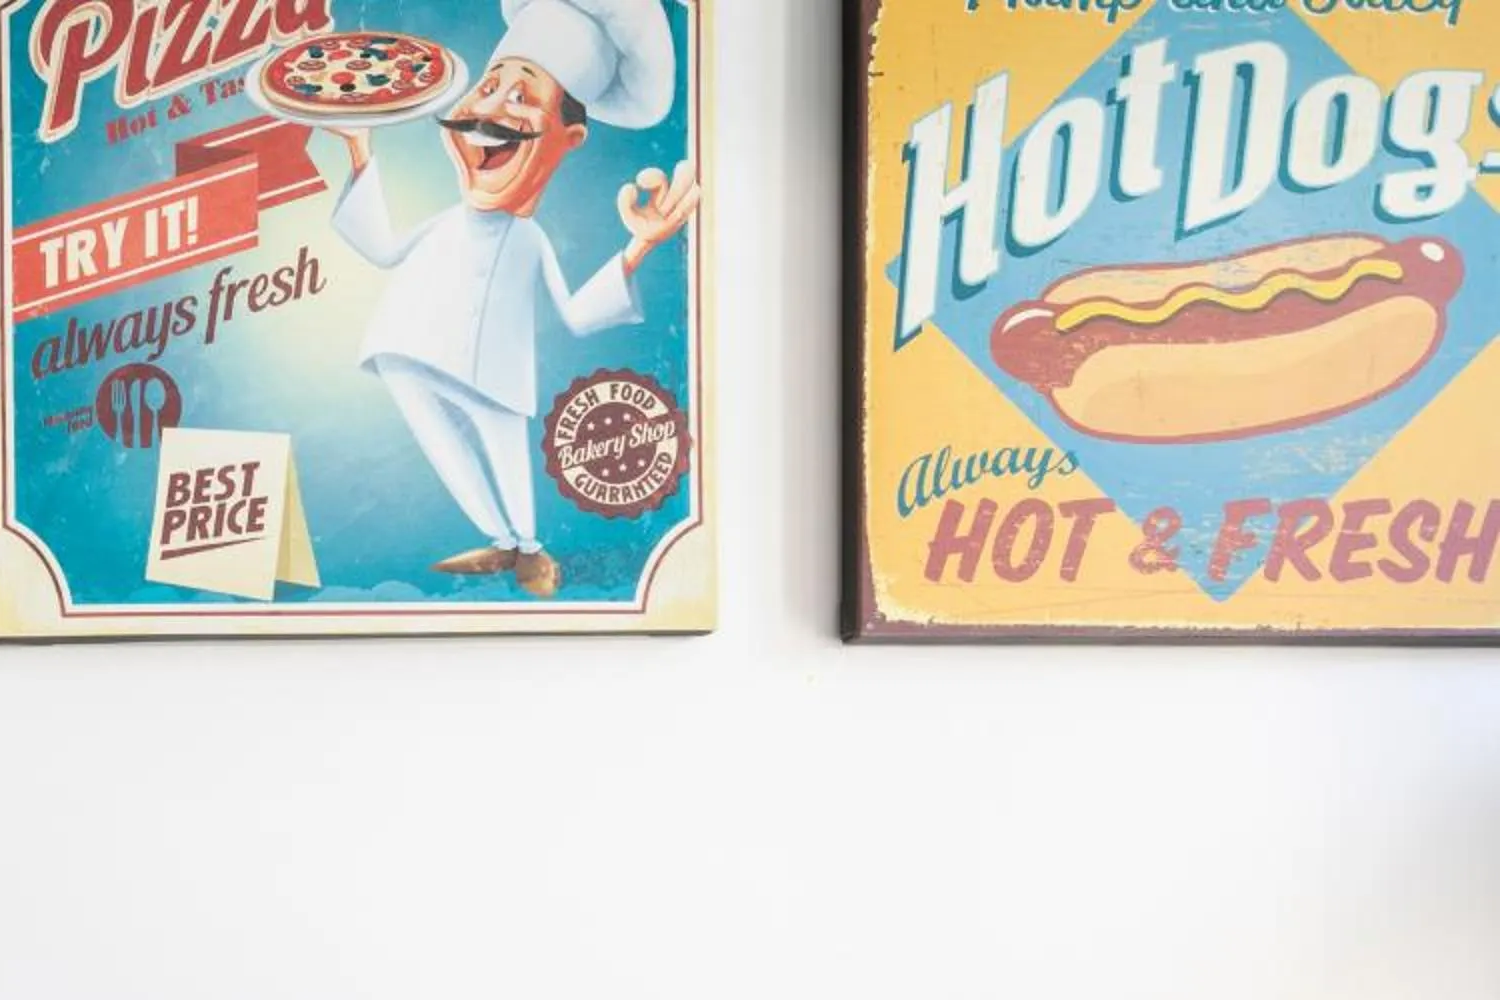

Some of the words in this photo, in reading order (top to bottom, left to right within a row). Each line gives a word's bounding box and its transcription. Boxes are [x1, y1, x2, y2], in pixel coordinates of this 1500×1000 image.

[167, 94, 192, 121] &
[201, 76, 246, 106] Tas
[1176, 41, 1500, 240] Dog
[39, 217, 129, 290] TRY
[143, 195, 200, 258] IT!
[31, 295, 199, 379] always
[203, 245, 328, 345] fresh
[557, 389, 601, 441] FRESH
[609, 383, 656, 411] FOOD
[557, 435, 626, 468] Bakery
[629, 420, 676, 449] Shop
[165, 460, 261, 509] BEST
[574, 451, 673, 503] GUARANTEED
[896, 444, 1081, 519] Always
[159, 496, 269, 545] PRICE
[923, 497, 1117, 583] HOT
[1127, 505, 1182, 575] &
[1206, 497, 1500, 585] FRESH
